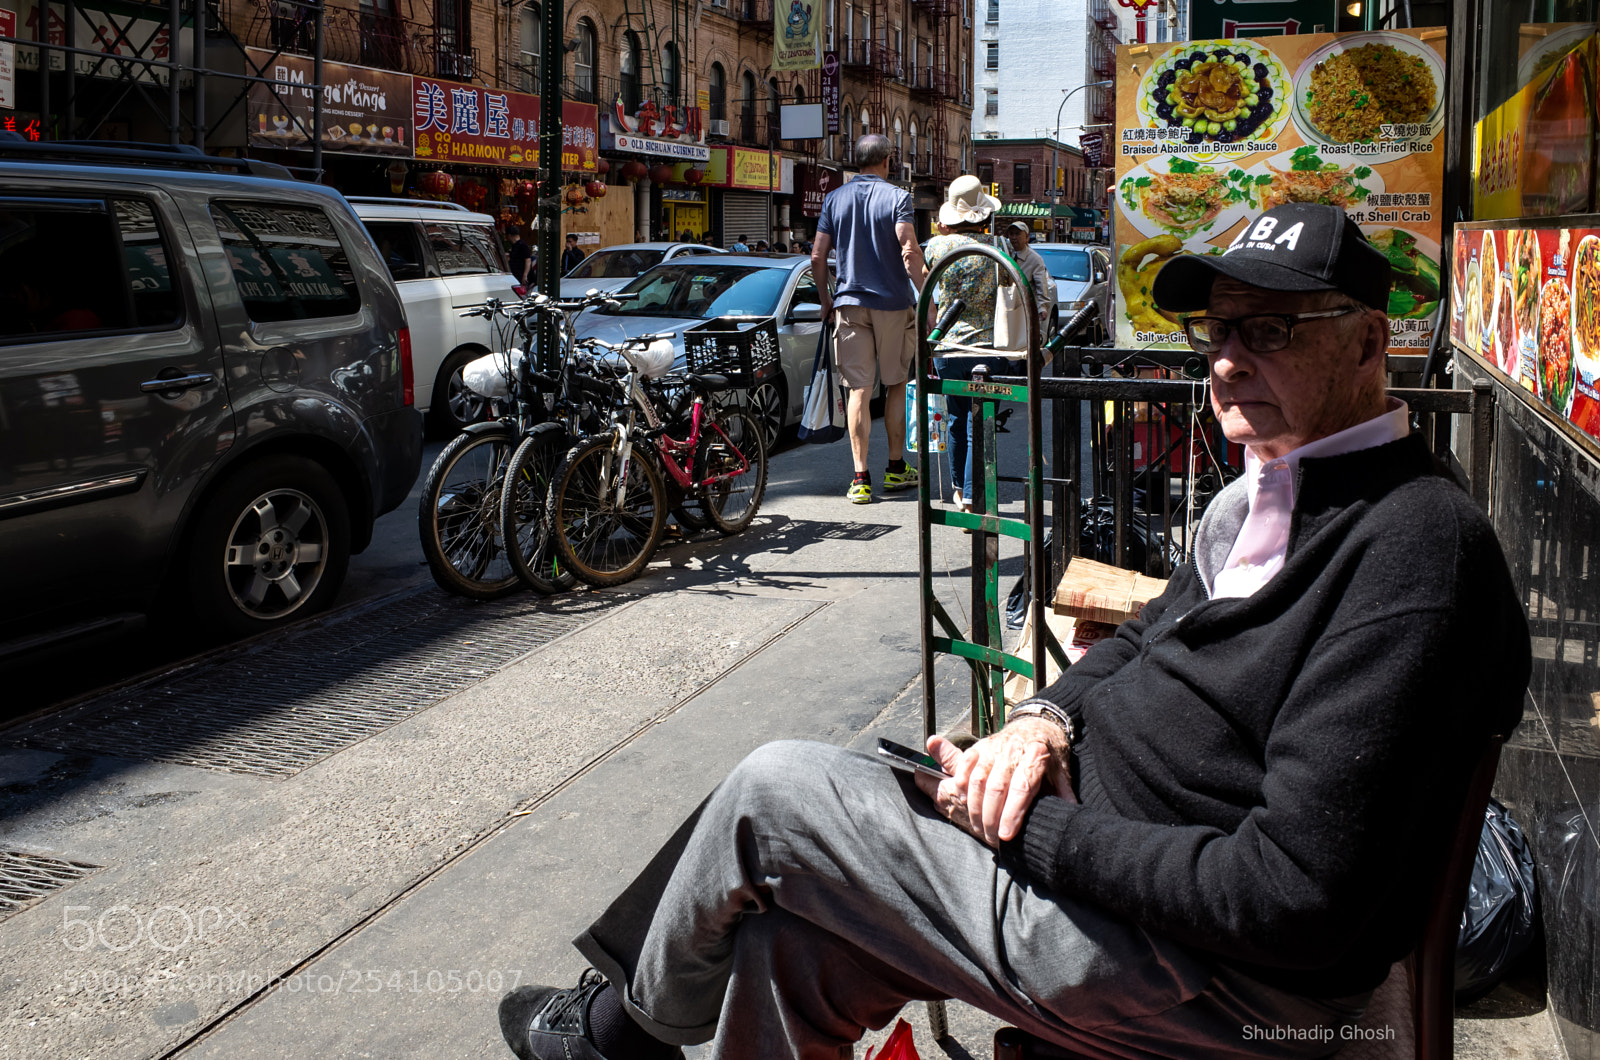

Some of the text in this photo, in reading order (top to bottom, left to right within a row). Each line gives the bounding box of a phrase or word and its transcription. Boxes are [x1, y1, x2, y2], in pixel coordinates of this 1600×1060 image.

[289, 69, 387, 112] Mago Mango
[359, 82, 380, 92] Dessert
[345, 109, 364, 118] DESSERT
[415, 81, 510, 139] 美麗屋
[1122, 128, 1192, 141] 紅燒海參鮑片
[1380, 123, 1432, 138] 叉燒炒飯
[434, 131, 452, 144] QQ
[437, 143, 449, 155] 63
[452, 139, 579, 166] HARMONY GIF NTER
[631, 139, 706, 159] OLD SICHUAN CUISINE INC.
[1122, 141, 1277, 155] Braised Abalone in Brown Sauce
[1321, 141, 1433, 154] Roast Pork Fried Rice
[1366, 193, 1431, 207] 椒鹽軟殼蟹
[1348, 210, 1431, 222] oft Shell Crab
[1229, 216, 1304, 251] BA
[1246, 241, 1256, 249] IN
[1256, 241, 1276, 252] CUBA
[1136, 331, 1154, 343] Salt
[1155, 333, 1168, 343] w.
[1408, 336, 1430, 347] salad
